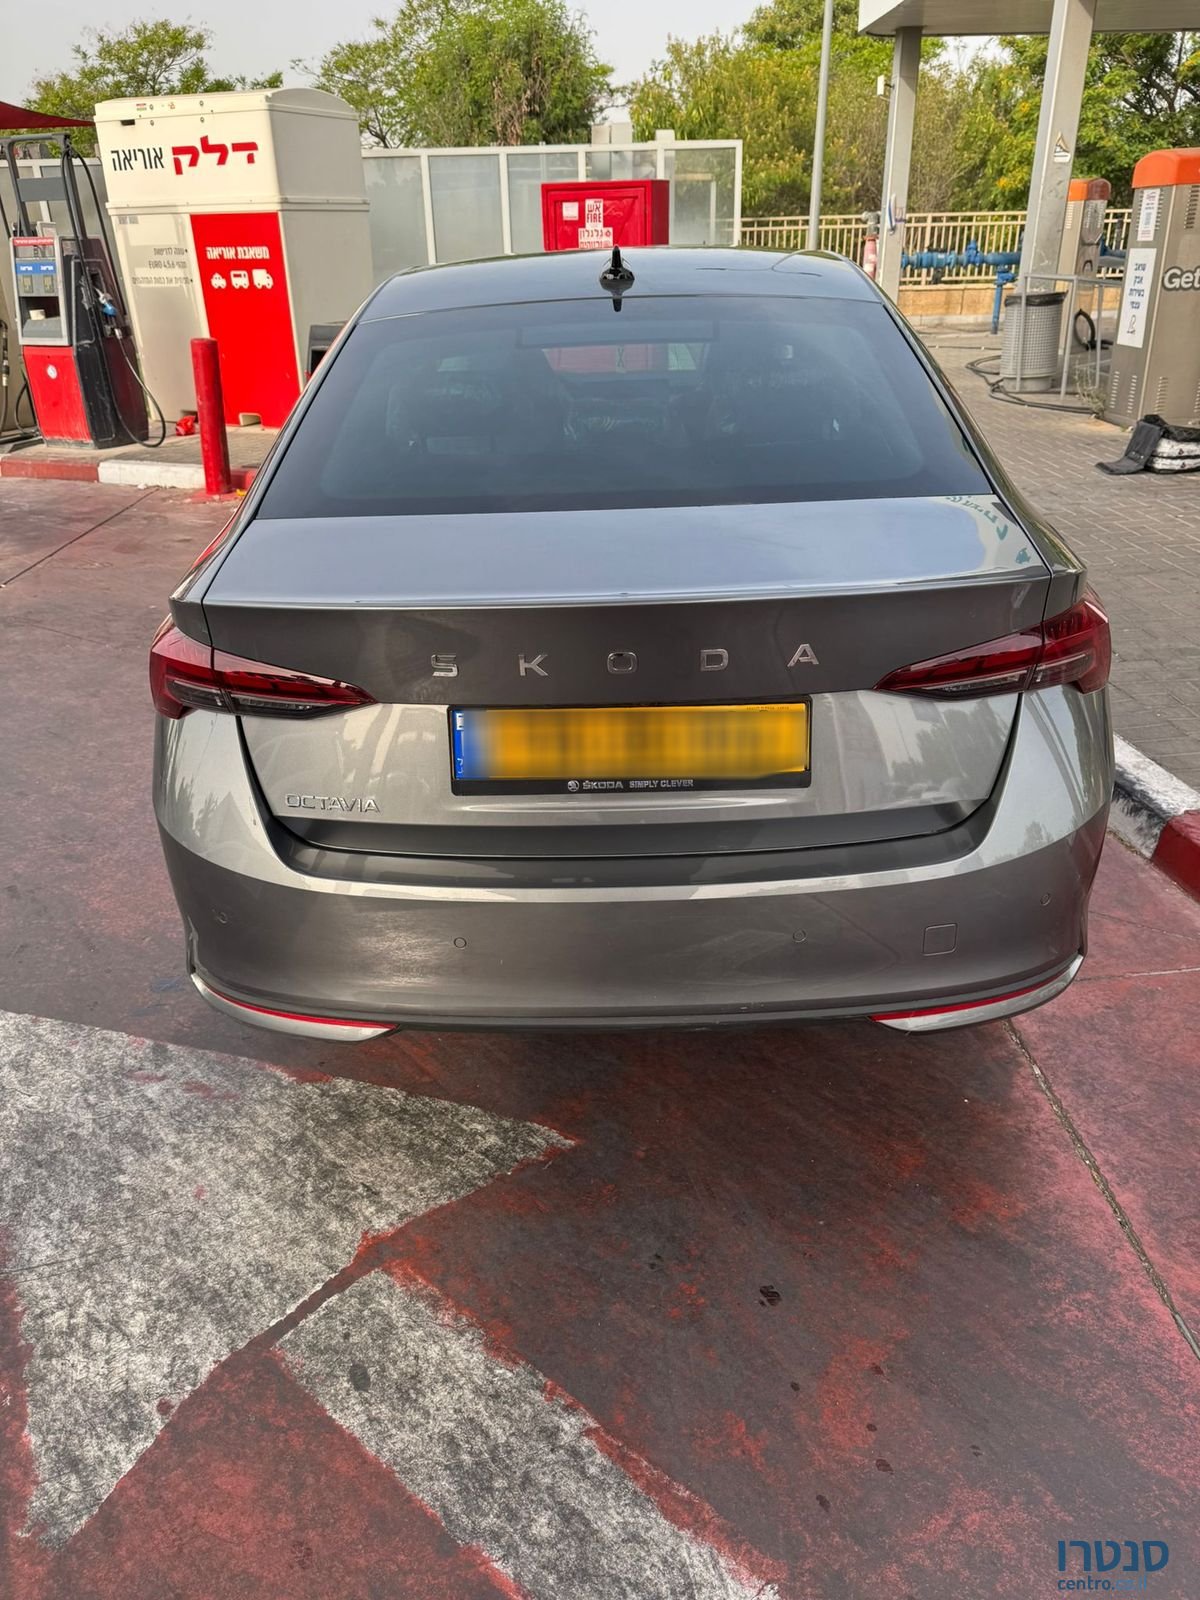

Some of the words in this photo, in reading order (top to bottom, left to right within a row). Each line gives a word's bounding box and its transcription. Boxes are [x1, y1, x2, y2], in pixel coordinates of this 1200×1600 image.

[111, 147, 164, 171] אוריאה
[172, 135, 258, 175] דלק
[587, 213, 601, 223] FIRE
[206, 247, 236, 259] אוריאה
[237, 246, 270, 259] משאבת
[582, 780, 623, 789] ŠKODA
[629, 780, 658, 788] SIMPLY
[660, 779, 694, 788] CLEVER
[285, 794, 380, 813] OCTAVIA
